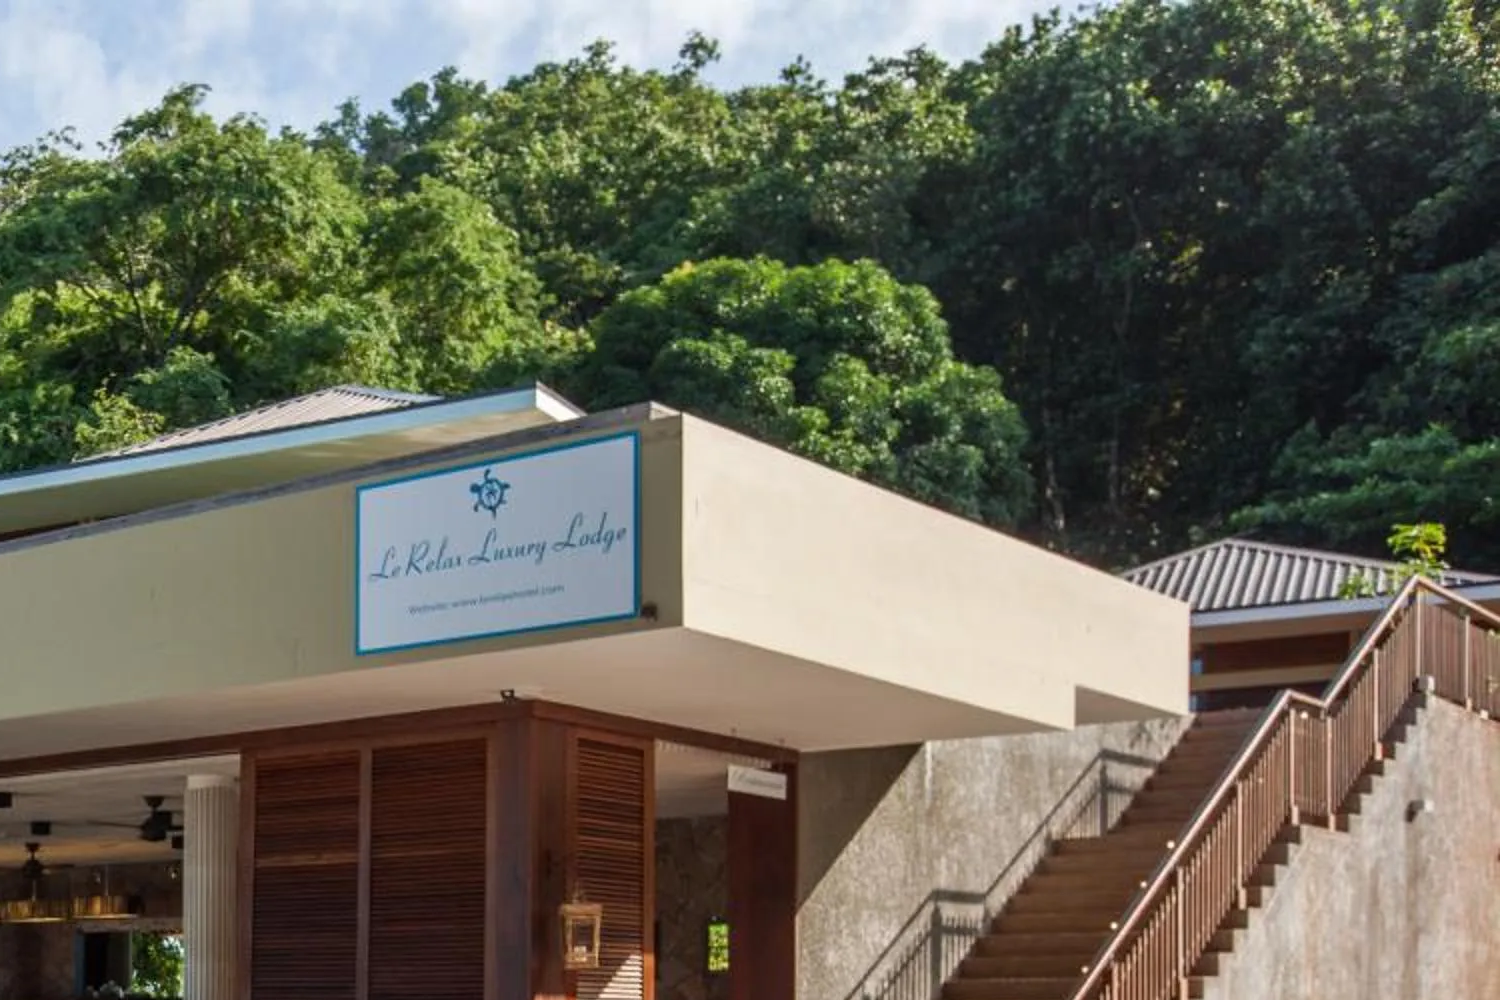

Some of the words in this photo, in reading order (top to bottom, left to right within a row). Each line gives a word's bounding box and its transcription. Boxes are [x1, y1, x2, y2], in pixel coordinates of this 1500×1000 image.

[368, 546, 401, 579] Le
[468, 528, 547, 565] Luxury
[552, 511, 627, 553] Lodge
